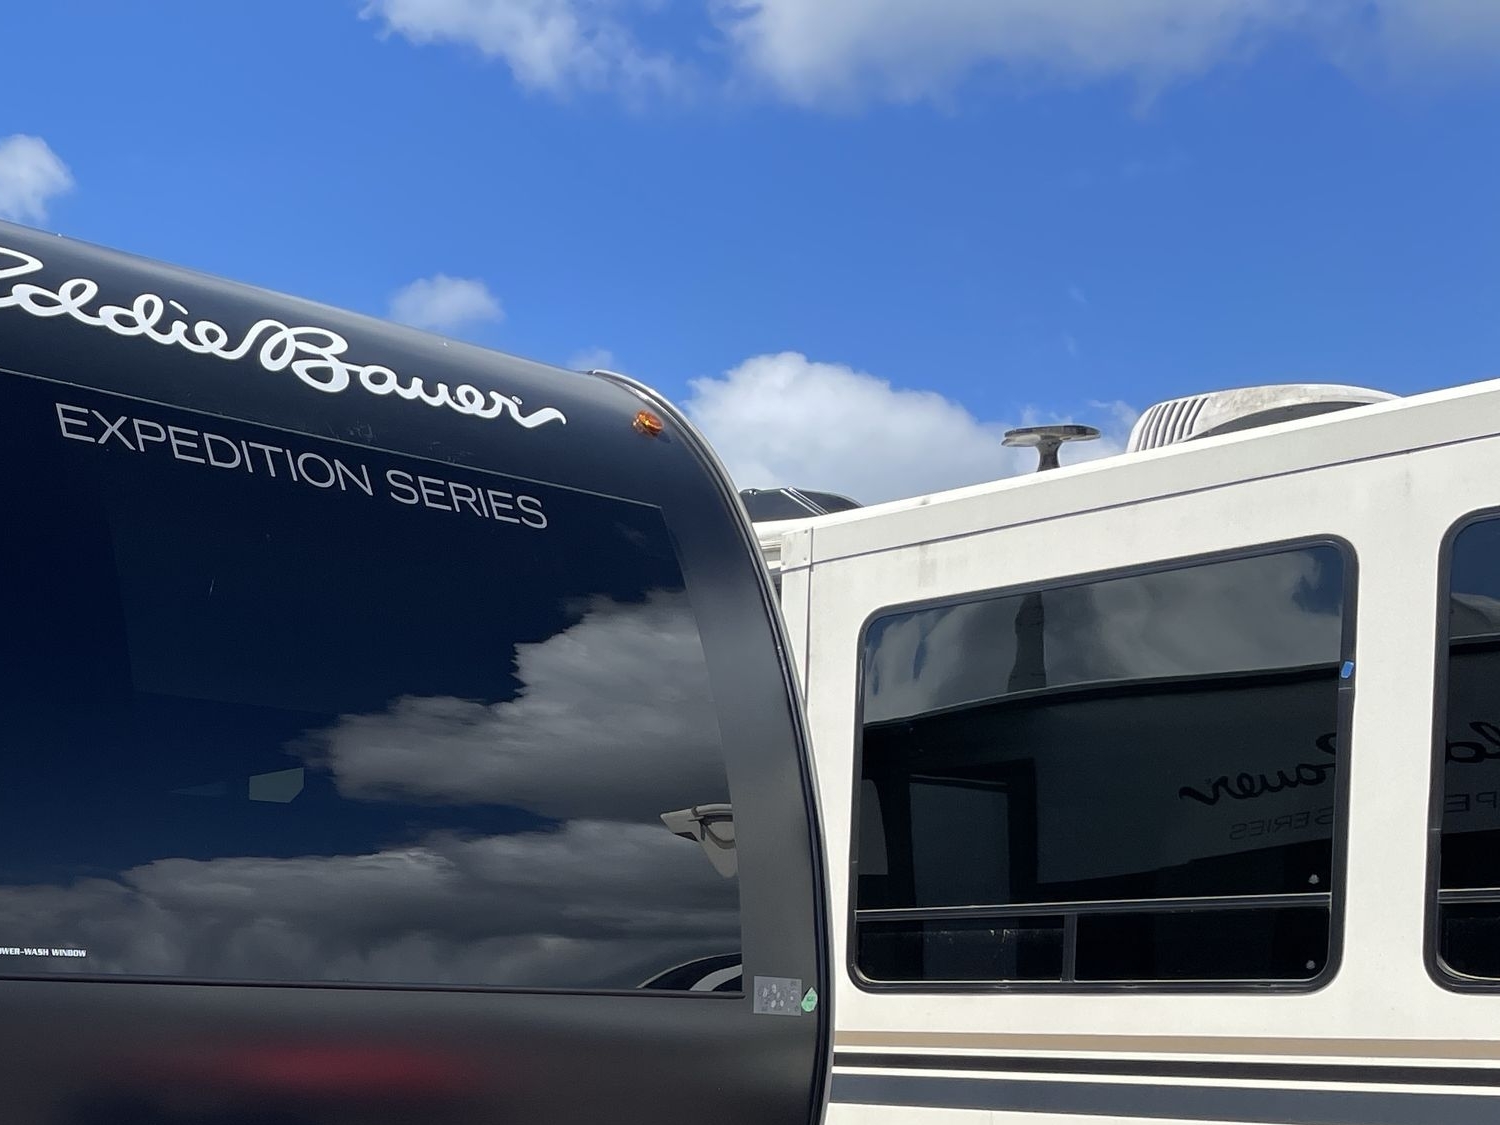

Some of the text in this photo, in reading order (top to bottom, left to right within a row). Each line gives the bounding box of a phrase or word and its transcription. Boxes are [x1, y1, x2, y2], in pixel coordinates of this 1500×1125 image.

[246, 318, 567, 429] Bauer
[55, 402, 548, 530] EXPEDITION SERIES
[51, 948, 87, 958] WINDOW
